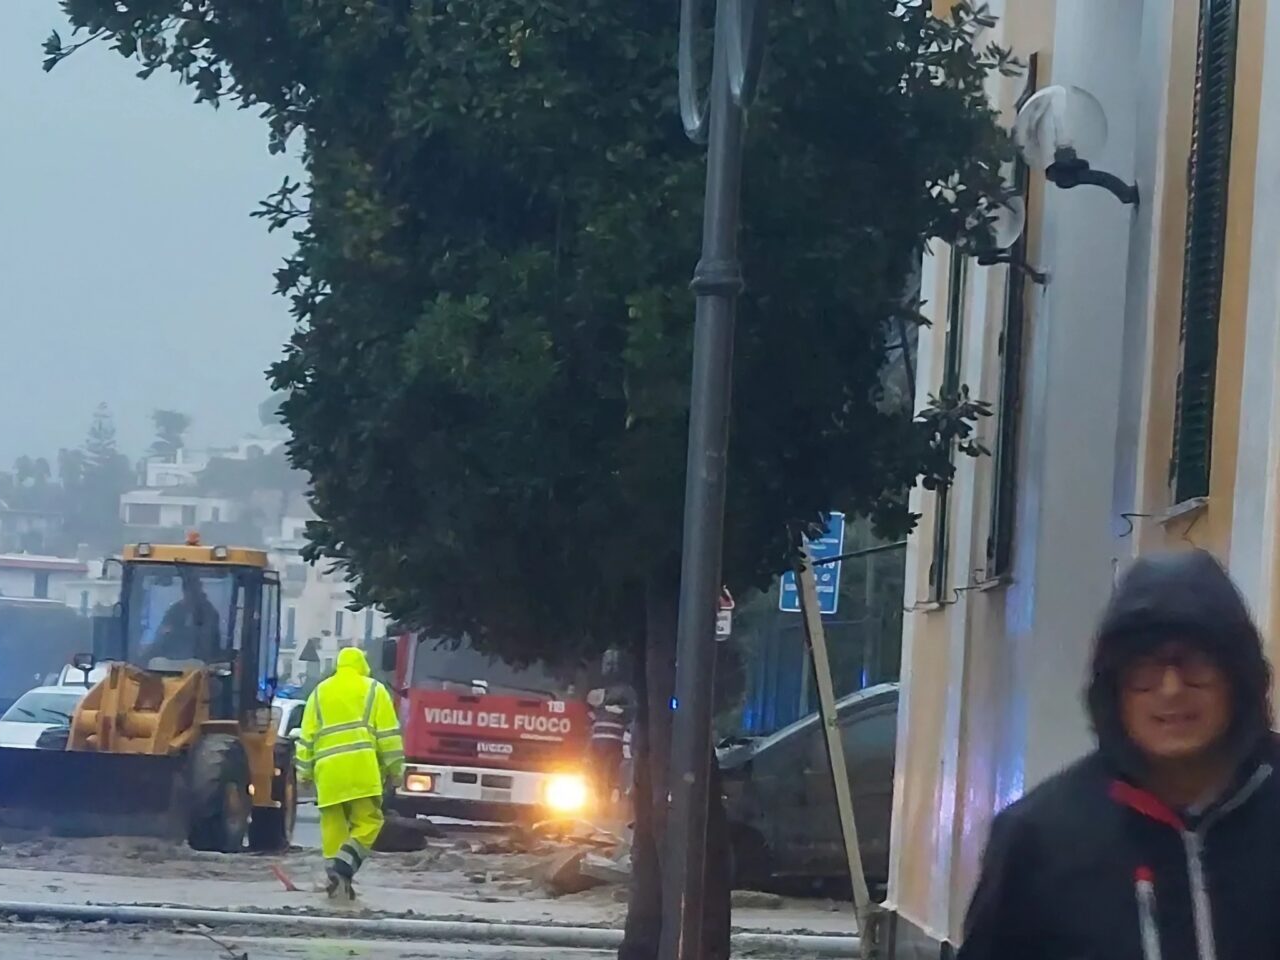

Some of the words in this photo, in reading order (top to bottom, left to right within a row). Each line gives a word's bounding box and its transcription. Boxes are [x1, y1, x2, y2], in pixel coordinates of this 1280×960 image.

[424, 707, 472, 725] VIGILI
[477, 712, 509, 728] DEL
[514, 715, 571, 733] FUOCO
